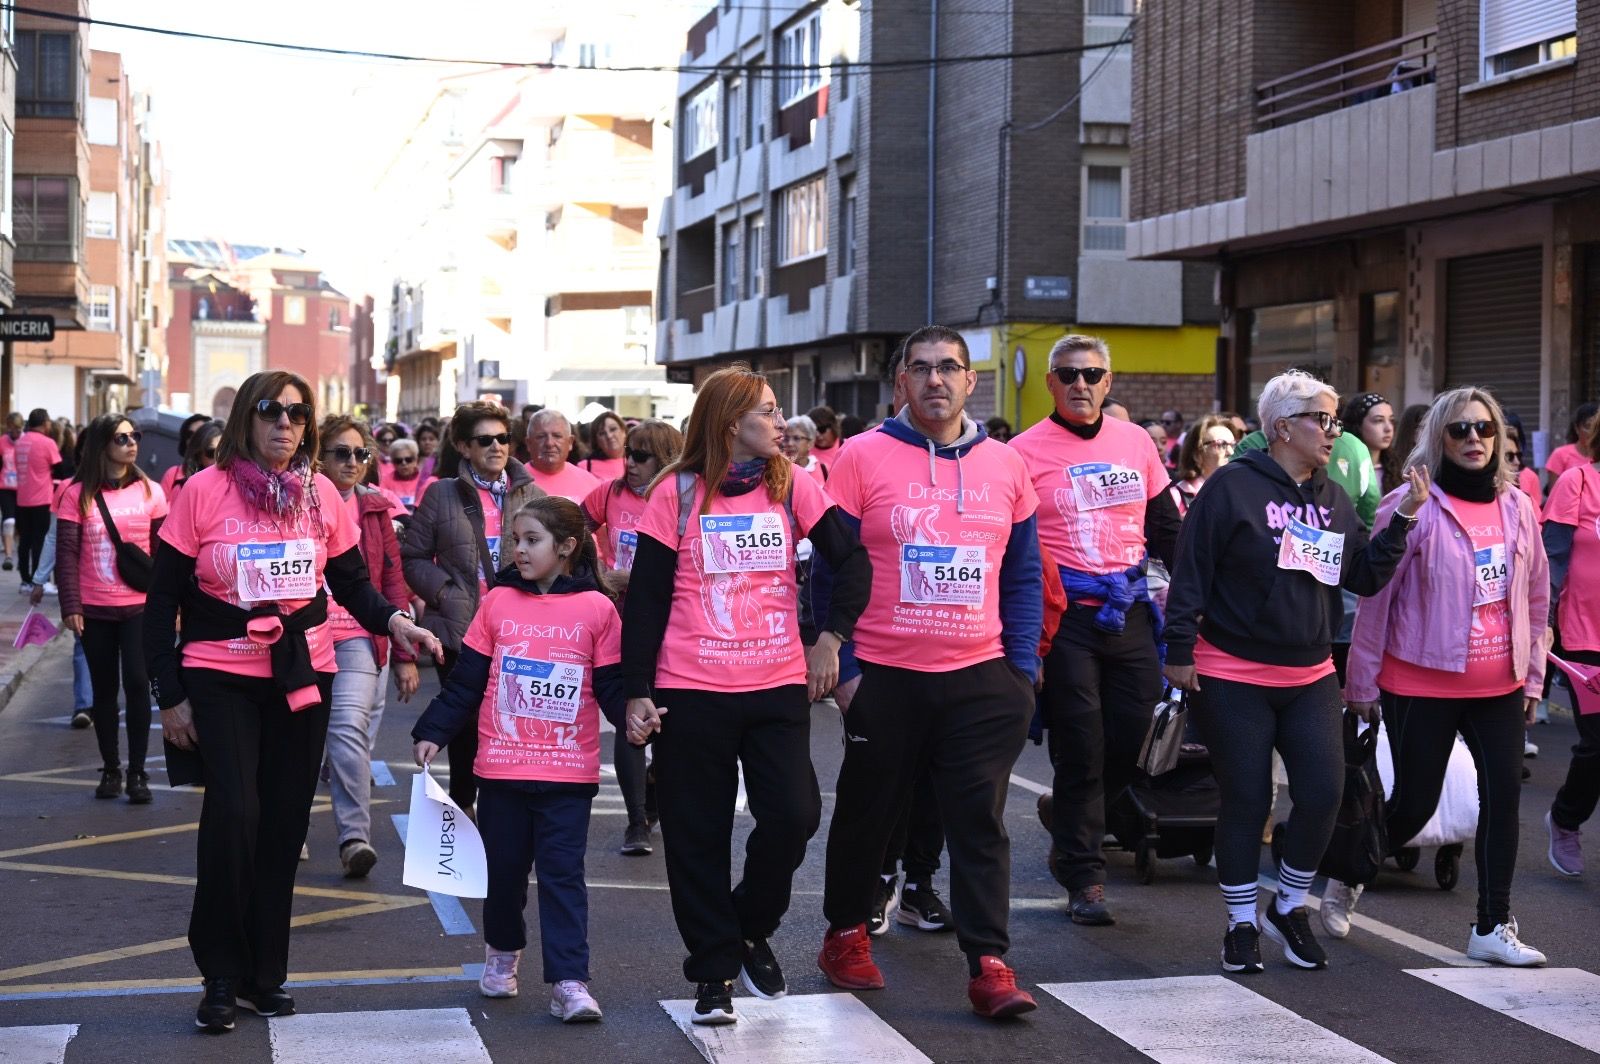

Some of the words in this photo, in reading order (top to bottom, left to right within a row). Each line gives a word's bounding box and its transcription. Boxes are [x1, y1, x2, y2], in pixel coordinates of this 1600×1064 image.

[1100, 472, 1139, 487] 1234
[736, 533, 783, 549] 5165
[1302, 543, 1341, 565] 2216
[270, 560, 313, 576] 5157
[934, 566, 982, 582] 5164
[893, 606, 933, 617] Carrera
[936, 610, 950, 618] de
[952, 612, 961, 620] la
[893, 616, 921, 625] almom
[891, 625, 917, 633] Contra
[699, 638, 739, 648] Carrera
[743, 640, 754, 648] de
[758, 639, 766, 647] la
[1492, 634, 1502, 644] de
[699, 649, 728, 657] almom
[742, 646, 790, 657] DRASANVI
[530, 680, 578, 700] 5167
[547, 699, 575, 707] Carrera
[488, 748, 514, 756] almom
[526, 751, 584, 760] DRASANVI
[438, 804, 458, 878] asanvi
